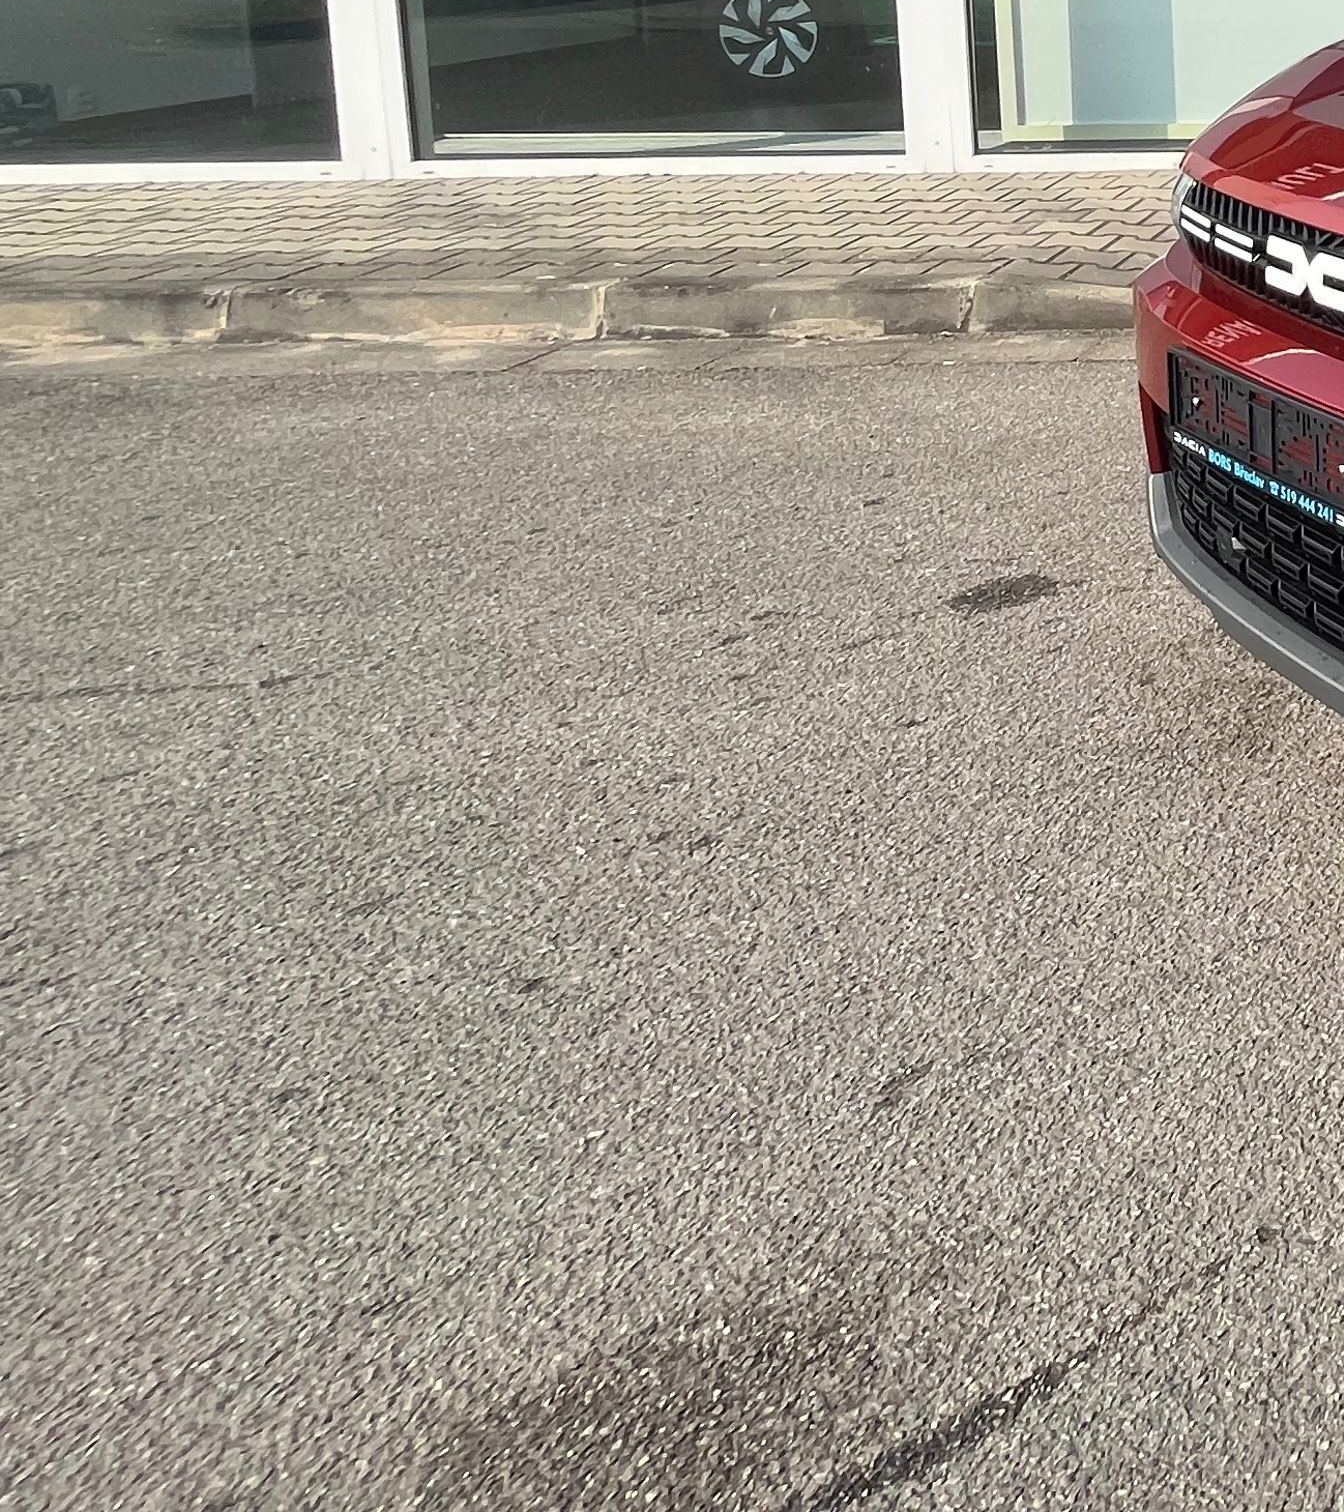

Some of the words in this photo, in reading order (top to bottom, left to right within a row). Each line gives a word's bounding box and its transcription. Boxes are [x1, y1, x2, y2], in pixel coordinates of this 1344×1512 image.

[1208, 448, 1232, 472] BORS
[1280, 486, 1297, 504] 519
[1299, 494, 1316, 515] 444
[1317, 502, 1334, 523] 241
